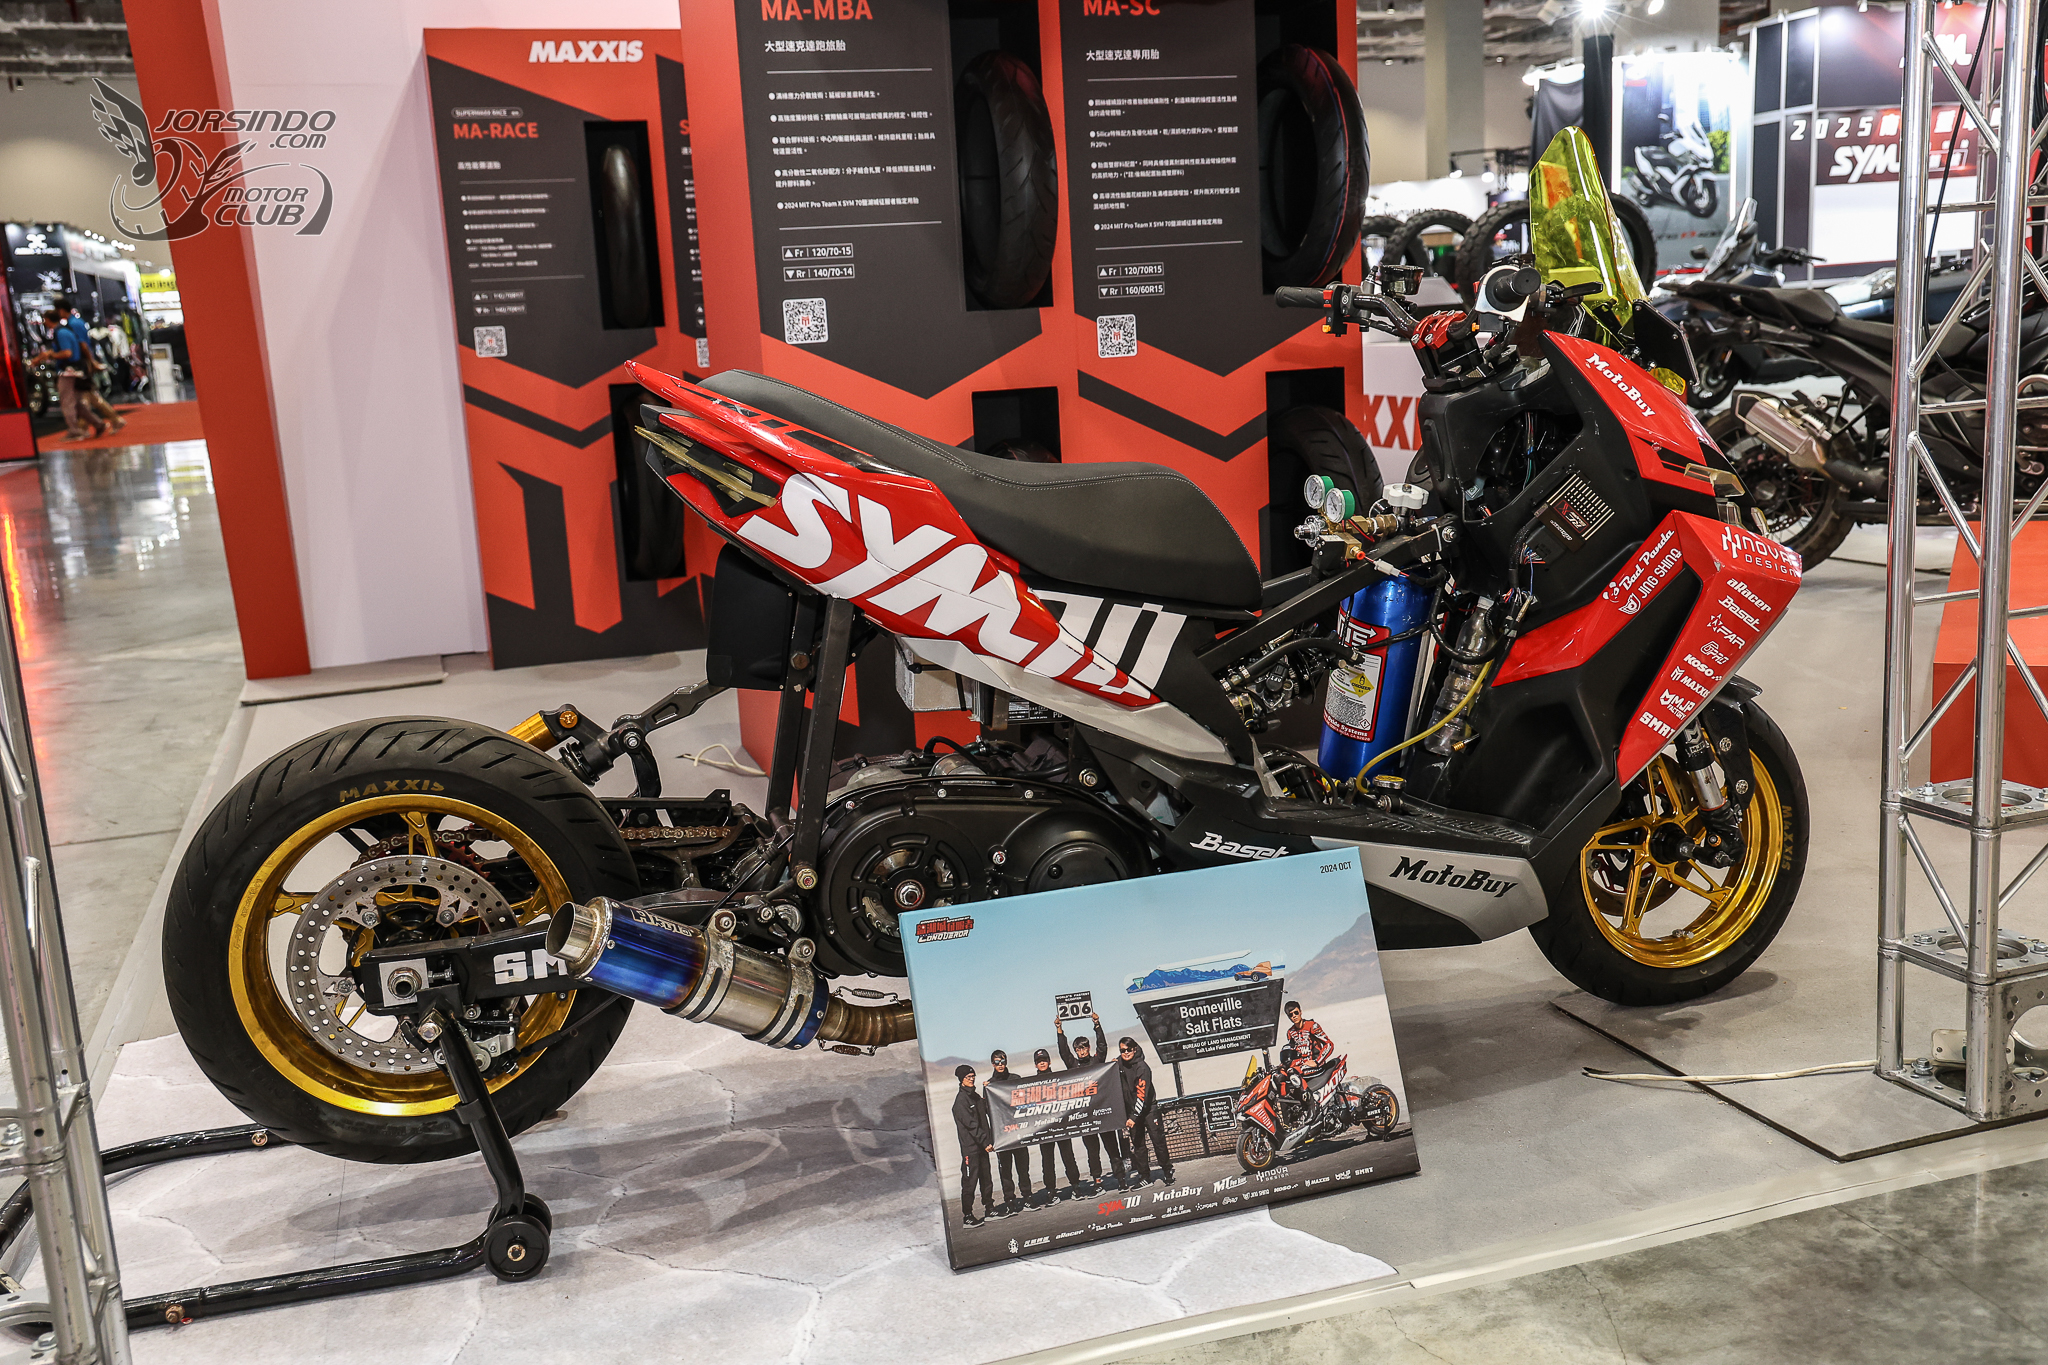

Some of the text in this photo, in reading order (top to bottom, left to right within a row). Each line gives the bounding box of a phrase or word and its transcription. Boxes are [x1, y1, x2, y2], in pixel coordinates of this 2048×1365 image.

[761, 0, 873, 21] MA-MBA
[1083, 0, 1160, 16] MA-SC
[528, 40, 643, 63] MAXXIS
[1086, 49, 1160, 61] 大型速克達專用胎
[453, 122, 539, 140] MA-RACE
[795, 247, 852, 257] Fr 120/70-15
[796, 267, 853, 278] Rr 140/70-14
[1108, 265, 1162, 276] Fr 120/70R15
[1109, 285, 1163, 296] Rr 160/60R15
[1585, 353, 1656, 417] MotoBuy
[737, 472, 1039, 664] SYM
[1619, 530, 1675, 591] Bad Panda
[1745, 554, 1798, 578] DESIGN
[1638, 575, 1659, 599] JING
[1726, 578, 1772, 613] aRacer
[1718, 595, 1760, 632] Baset
[1683, 654, 1714, 677] KOSO
[1671, 694, 1696, 713] MJP
[1341, 724, 1368, 737] Systems
[340, 779, 445, 803] MAXXIS
[1189, 831, 1290, 860] Baset
[1781, 805, 1794, 871] MAXXIS
[1320, 860, 1352, 874] 2024 OCT
[1388, 855, 1519, 898] MotoBuy
[918, 930, 970, 943] CONQUEROR
[493, 948, 568, 985] SM
[1059, 1003, 1091, 1018] 206
[1180, 997, 1242, 1019] Bonneville
[1185, 1016, 1242, 1035] Salt Flats
[1220, 1033, 1251, 1044] MANAGEMENT
[1057, 1075, 1093, 1087] SPEEDWAY
[1010, 1080, 1098, 1107] 鹽湖城征服者
[1014, 1096, 1092, 1118] CONQUEROR
[1097, 1199, 1125, 1216] SYM
[1152, 1185, 1202, 1204] MotoBuy
[1055, 1230, 1084, 1239] aRacer
